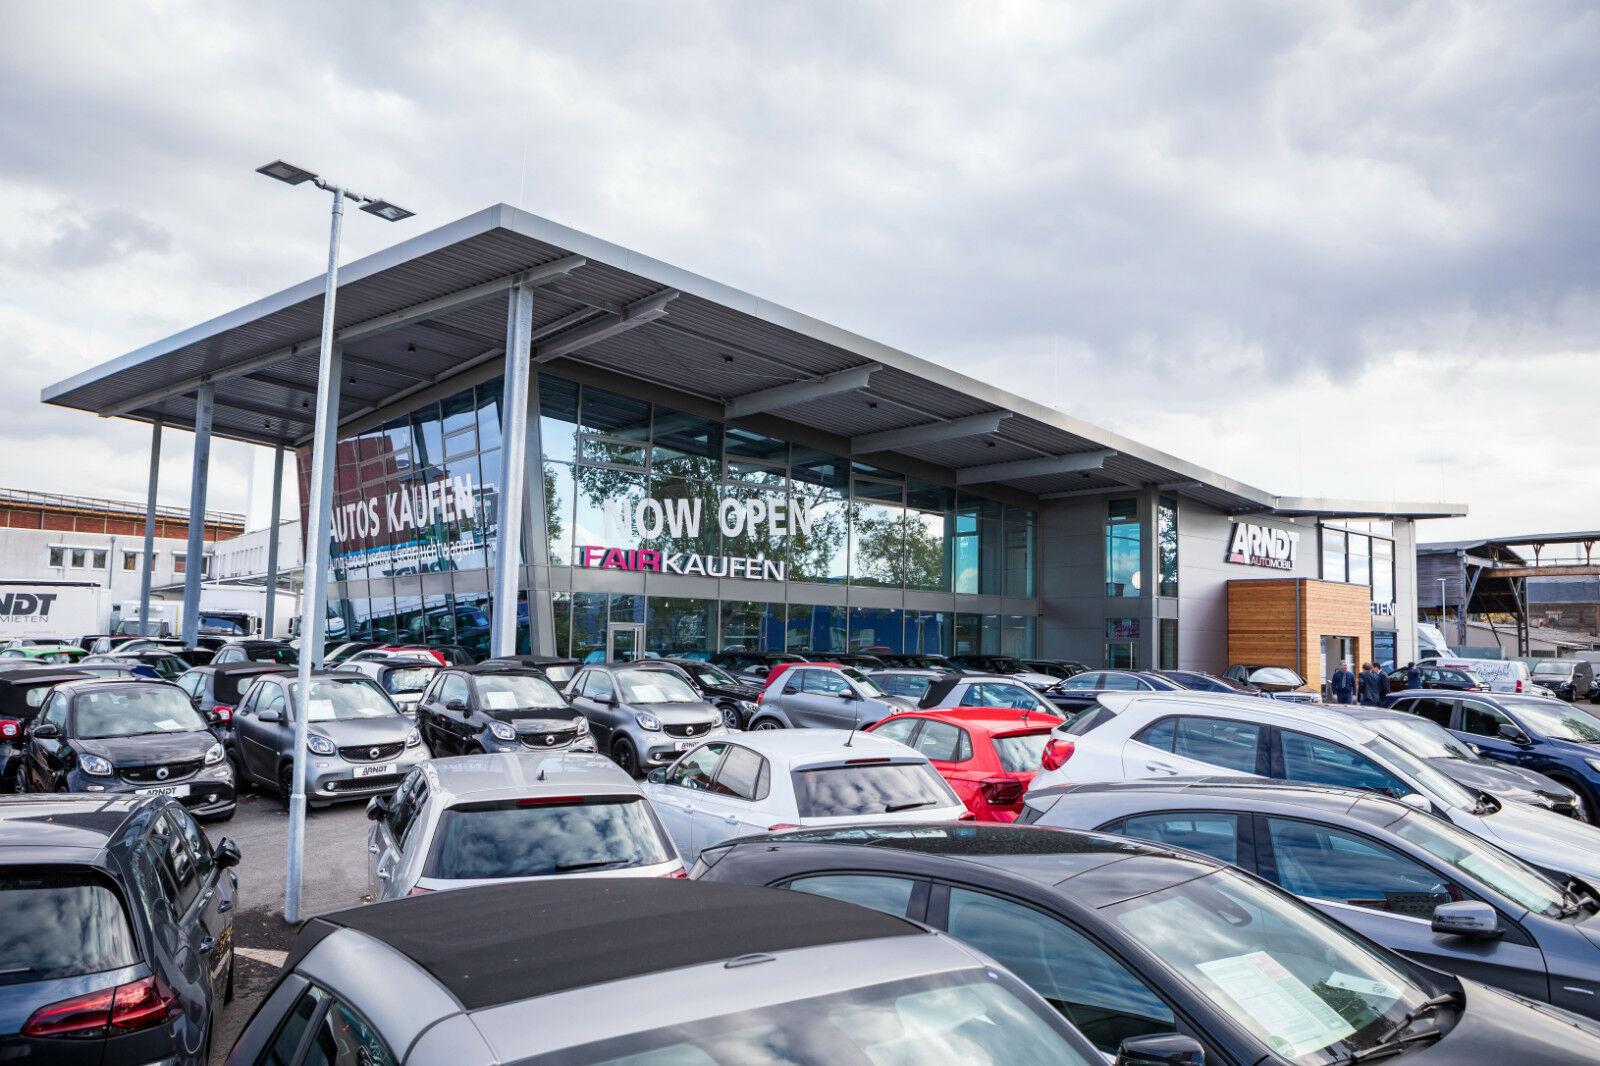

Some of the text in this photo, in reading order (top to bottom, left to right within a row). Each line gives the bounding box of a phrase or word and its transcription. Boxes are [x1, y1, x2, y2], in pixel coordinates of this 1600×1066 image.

[331, 473, 475, 543] AUTOS KAUFEN
[603, 498, 812, 540] NOW OPEN
[1231, 522, 1300, 564] ARNDT
[0, 615, 49, 623] MIETEN
[362, 766, 387, 775] ARNDT
[147, 787, 177, 796] ARNDT
